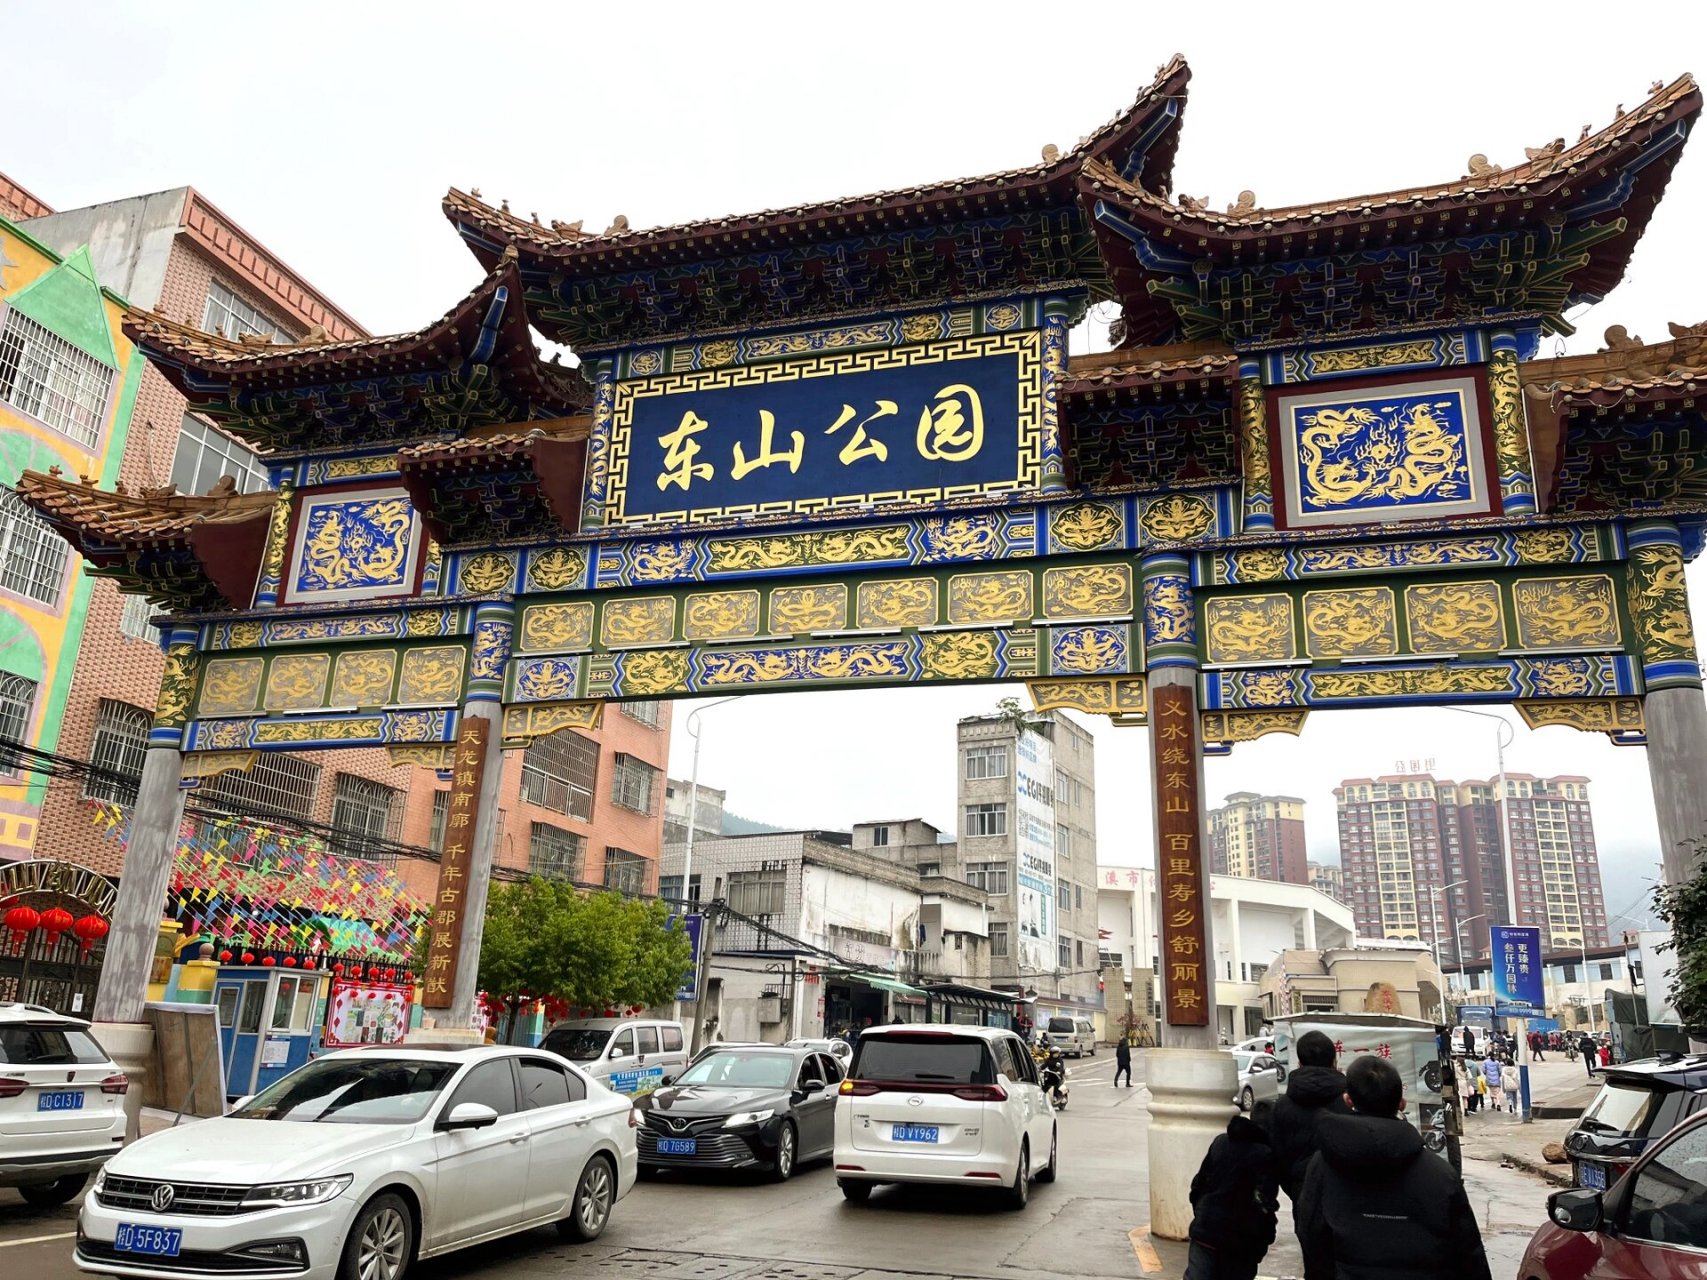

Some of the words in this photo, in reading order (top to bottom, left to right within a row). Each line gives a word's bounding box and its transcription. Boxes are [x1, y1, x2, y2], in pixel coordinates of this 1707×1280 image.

[656, 383, 985, 492] 东山公园
[1160, 699, 1190, 814] 义水绕东山
[1165, 833, 1202, 1009] 百里寿乡舒丽景
